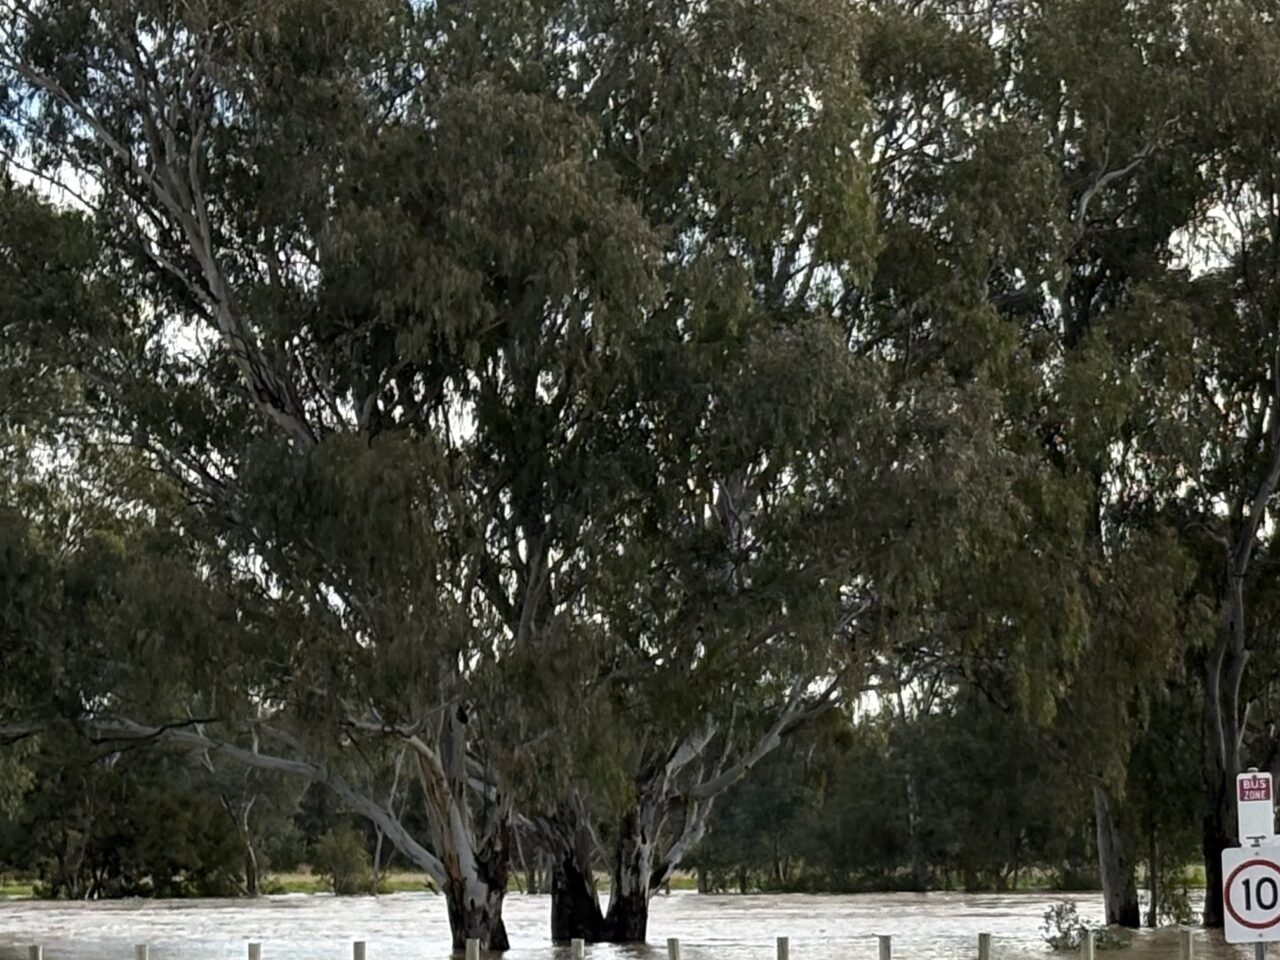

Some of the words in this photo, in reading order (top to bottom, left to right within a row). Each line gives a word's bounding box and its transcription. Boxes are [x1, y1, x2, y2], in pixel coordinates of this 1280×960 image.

[1243, 779, 1266, 789] BUS
[1243, 790, 1266, 800] ZONE
[1241, 877, 1278, 911] 10
